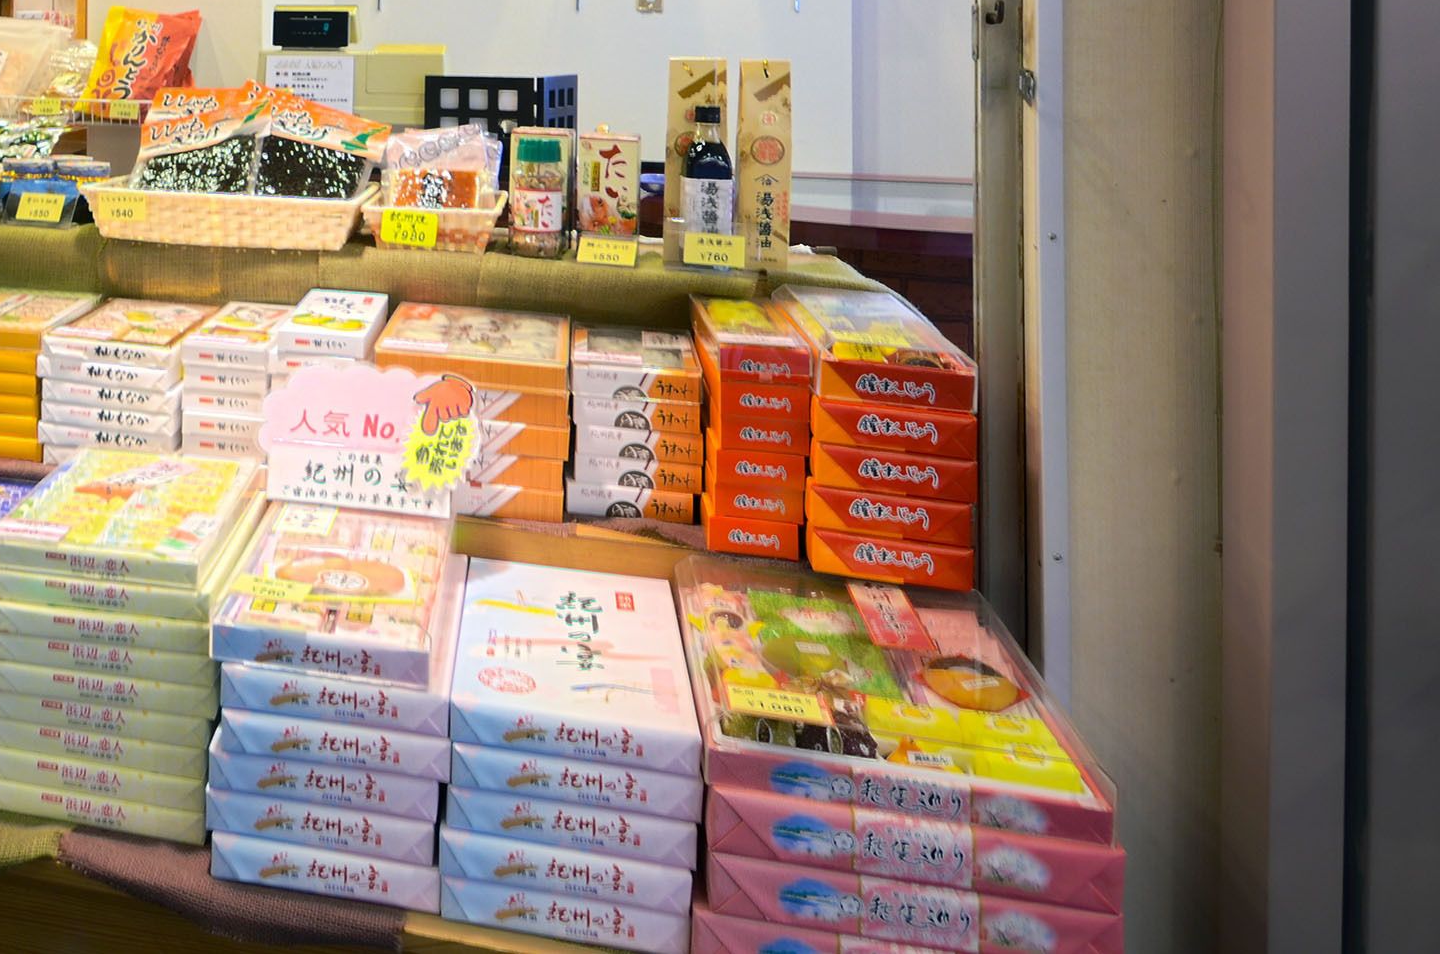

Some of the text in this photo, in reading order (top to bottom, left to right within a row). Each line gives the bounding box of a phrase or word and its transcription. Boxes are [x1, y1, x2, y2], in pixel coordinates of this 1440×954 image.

[112, 29, 158, 100] かりんとう
[699, 251, 730, 263] ¥760
[289, 408, 351, 438] 人気
[69, 555, 131, 573] 浜辺の恋人
[68, 583, 131, 601] 浜辺の恋人
[77, 618, 140, 637] 浜辺の恋人
[72, 646, 134, 665] 浜辺の恋人
[77, 677, 139, 696] 浜辺の恋人
[65, 705, 127, 725] 浜辺の恋人
[62, 733, 124, 753] 浜辺の恋人
[61, 767, 122, 787] 浜辺の恋人
[66, 800, 128, 820] 浜辺の恋人
